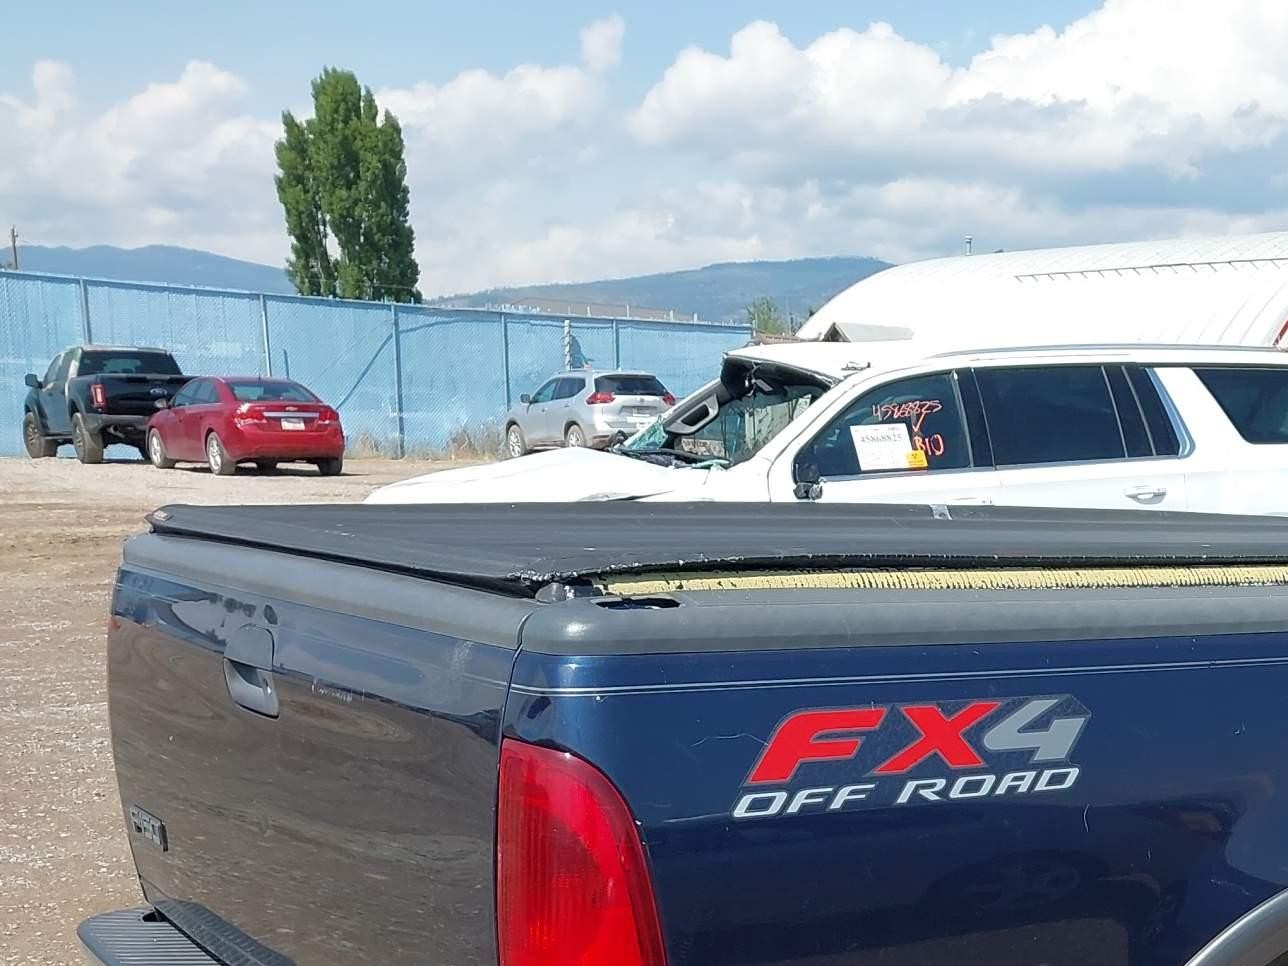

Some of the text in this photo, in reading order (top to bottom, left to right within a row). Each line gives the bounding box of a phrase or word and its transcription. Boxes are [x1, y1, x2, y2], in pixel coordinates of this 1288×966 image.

[747, 700, 1086, 785] FX4
[732, 767, 1080, 818] OFF ROAD
